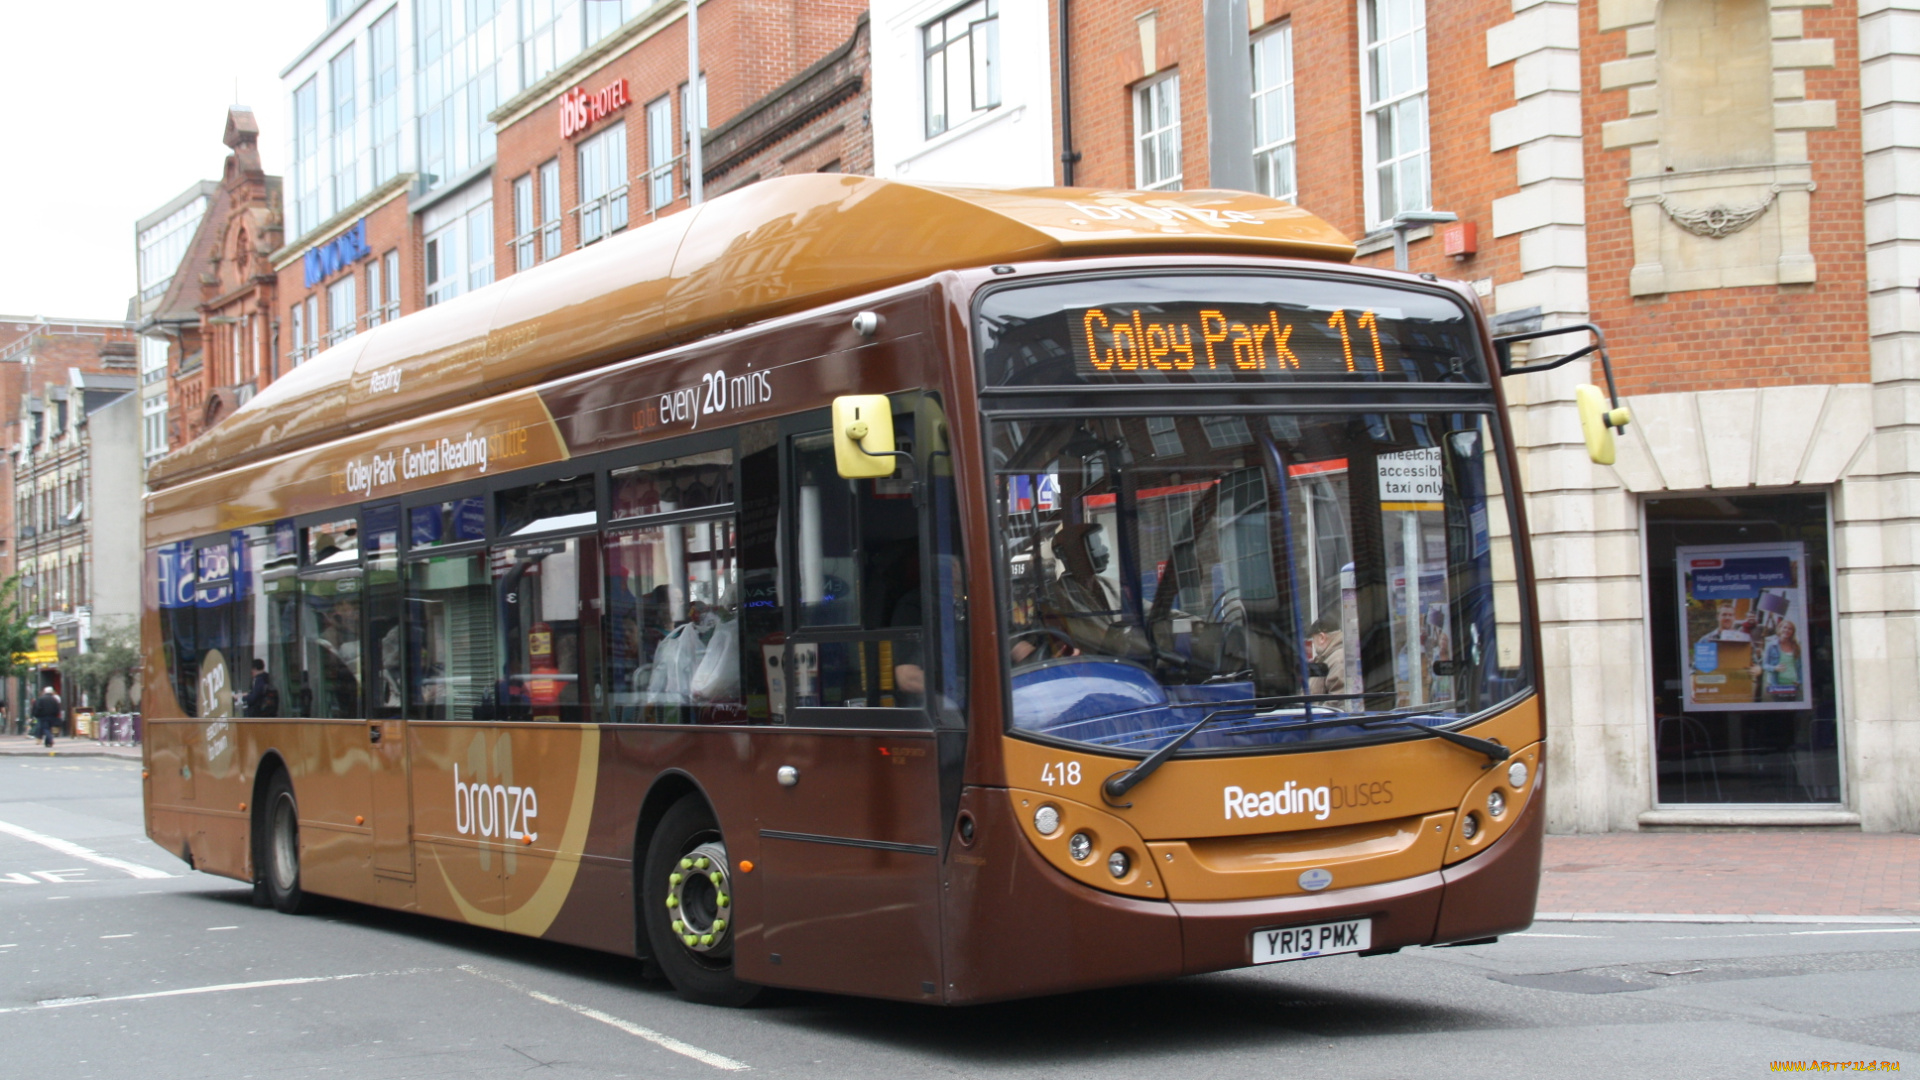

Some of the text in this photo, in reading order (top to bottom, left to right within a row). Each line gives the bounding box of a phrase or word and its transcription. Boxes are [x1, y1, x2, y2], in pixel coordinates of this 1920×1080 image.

[560, 79, 630, 139] ibis HOTEL
[1065, 201, 1264, 225] bronze
[1084, 308, 1385, 373] Coley Park 11
[369, 365, 403, 395] Reading
[632, 362, 772, 436] up to every 20 mins
[346, 459, 373, 497] Coley
[373, 451, 397, 486] Park
[402, 440, 440, 480] Central
[441, 431, 487, 472] Reading
[489, 420, 528, 461] shuttle
[1386, 481, 1443, 496] taxi only
[1709, 583, 1751, 593] generations
[1724, 572, 1740, 581] first
[1741, 572, 1757, 580] time
[1759, 572, 1784, 581] buyers
[1041, 761, 1082, 786] 418
[454, 762, 538, 842] bronze
[1267, 923, 1358, 955] YR13 PMX
